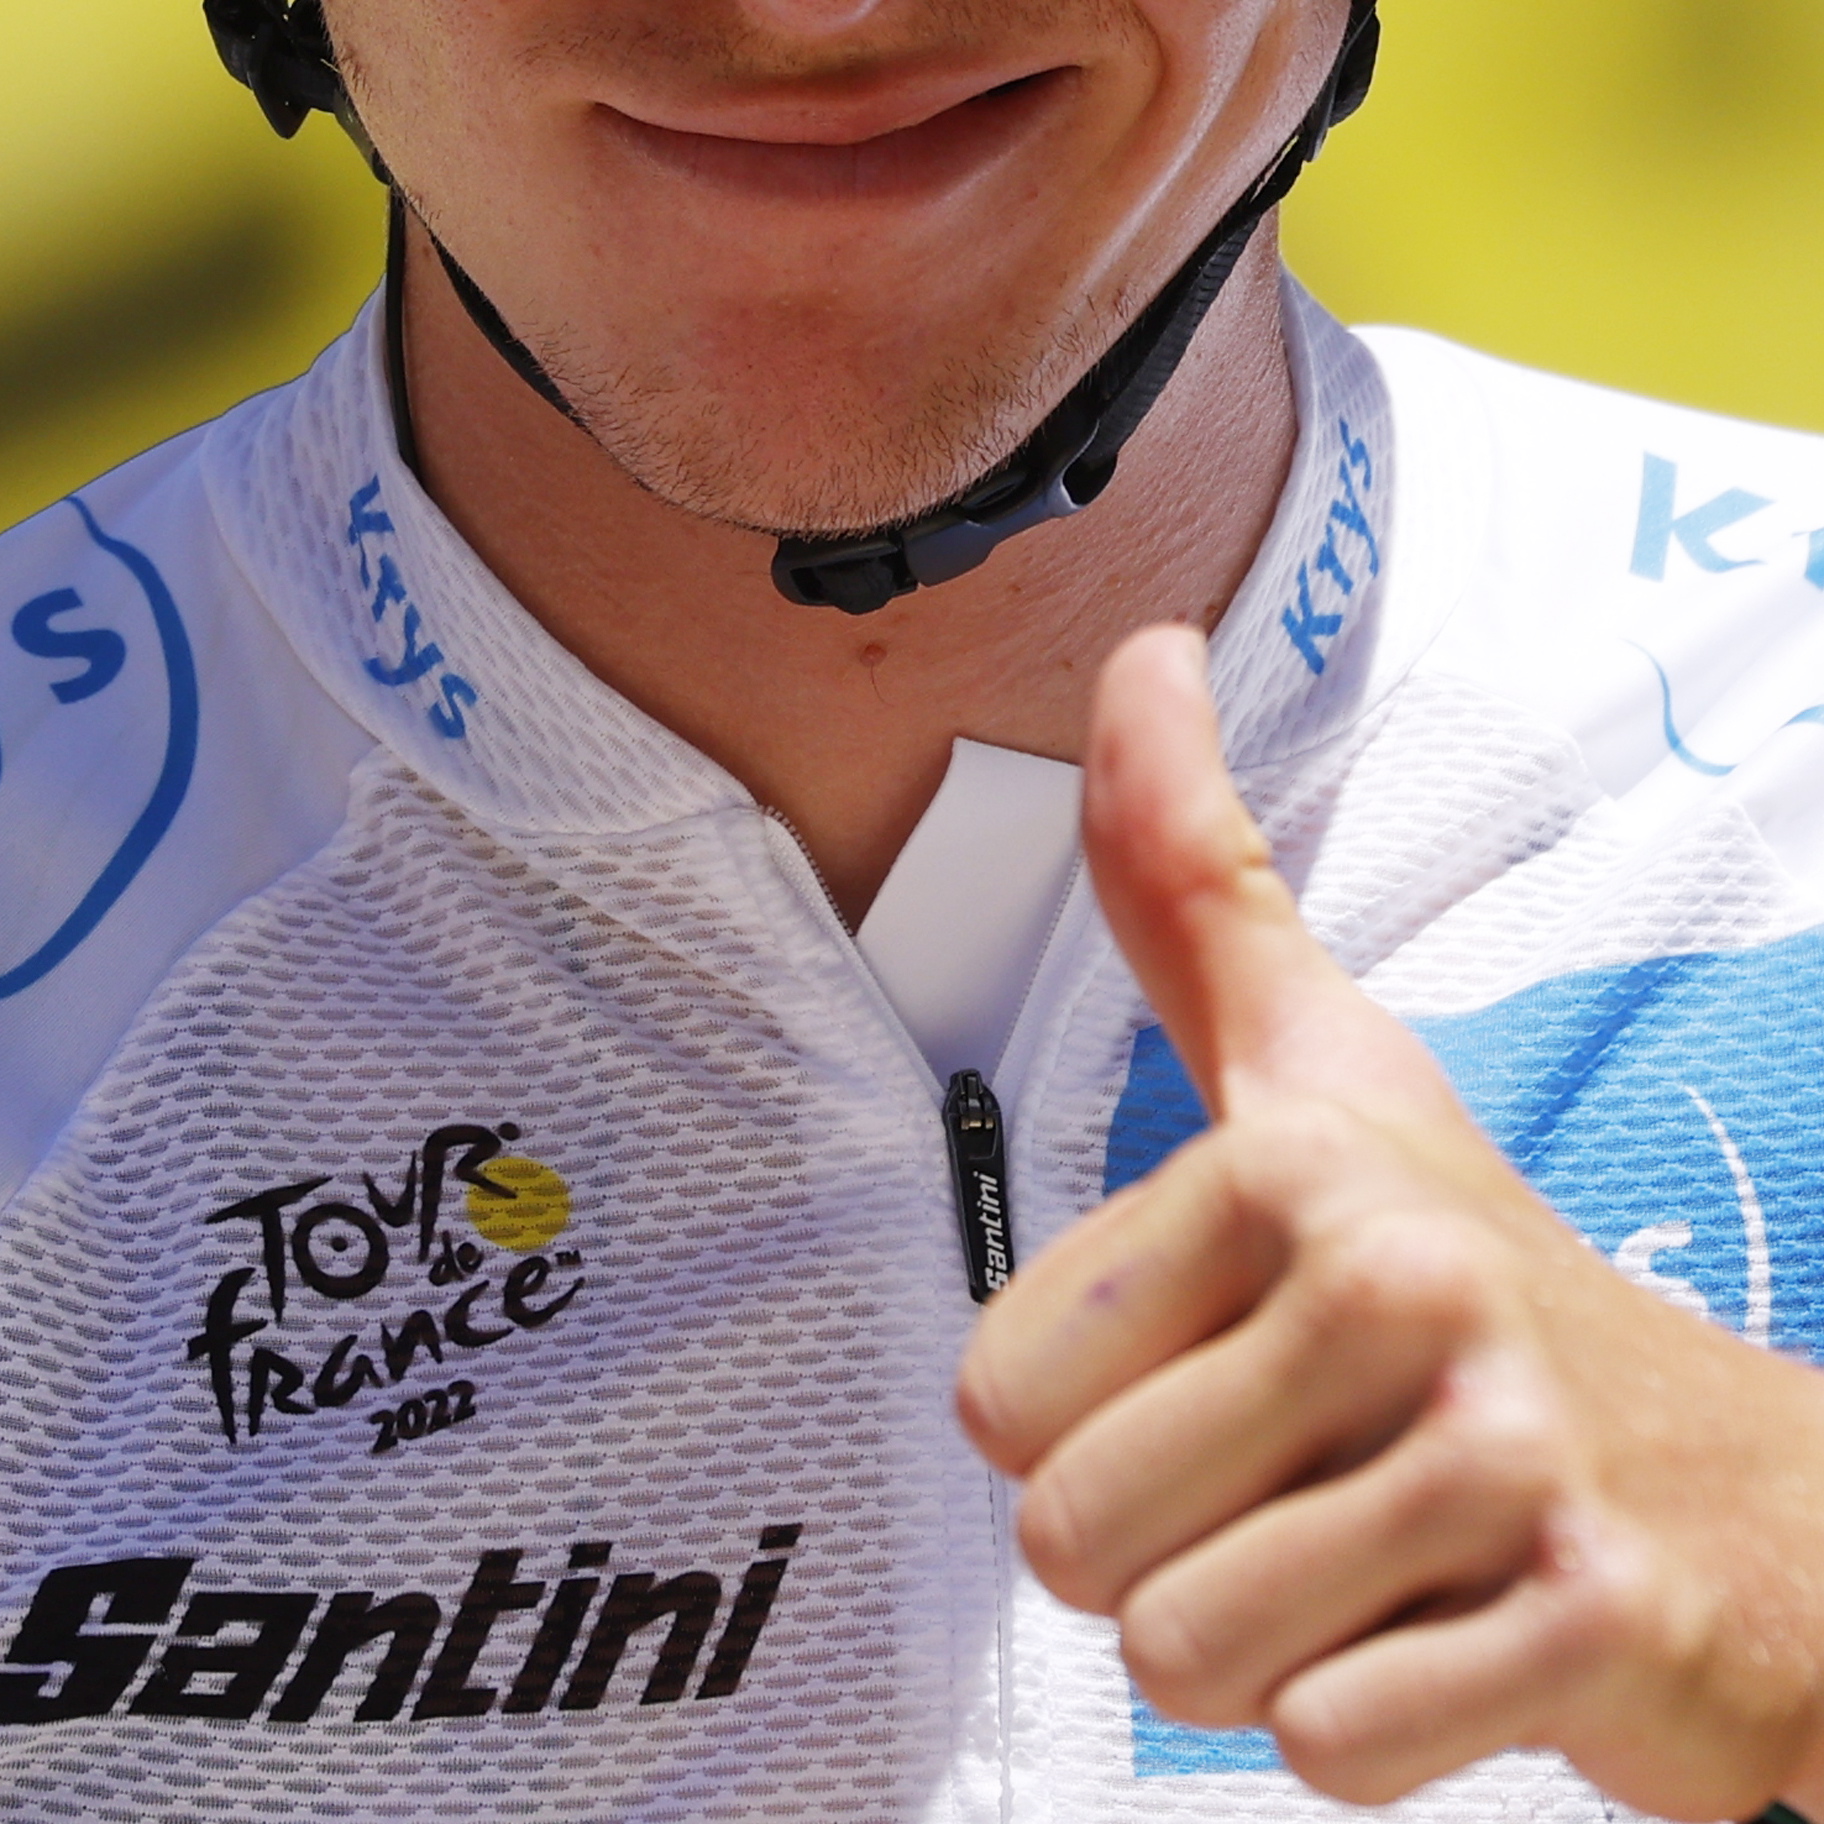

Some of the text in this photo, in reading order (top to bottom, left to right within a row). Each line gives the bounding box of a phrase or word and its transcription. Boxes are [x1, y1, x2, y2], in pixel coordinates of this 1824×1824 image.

[348, 472, 478, 739] Krys
[1280, 416, 1380, 676] Krys
[429, 1232, 483, 1287] de
[370, 1379, 477, 1455] 2022
